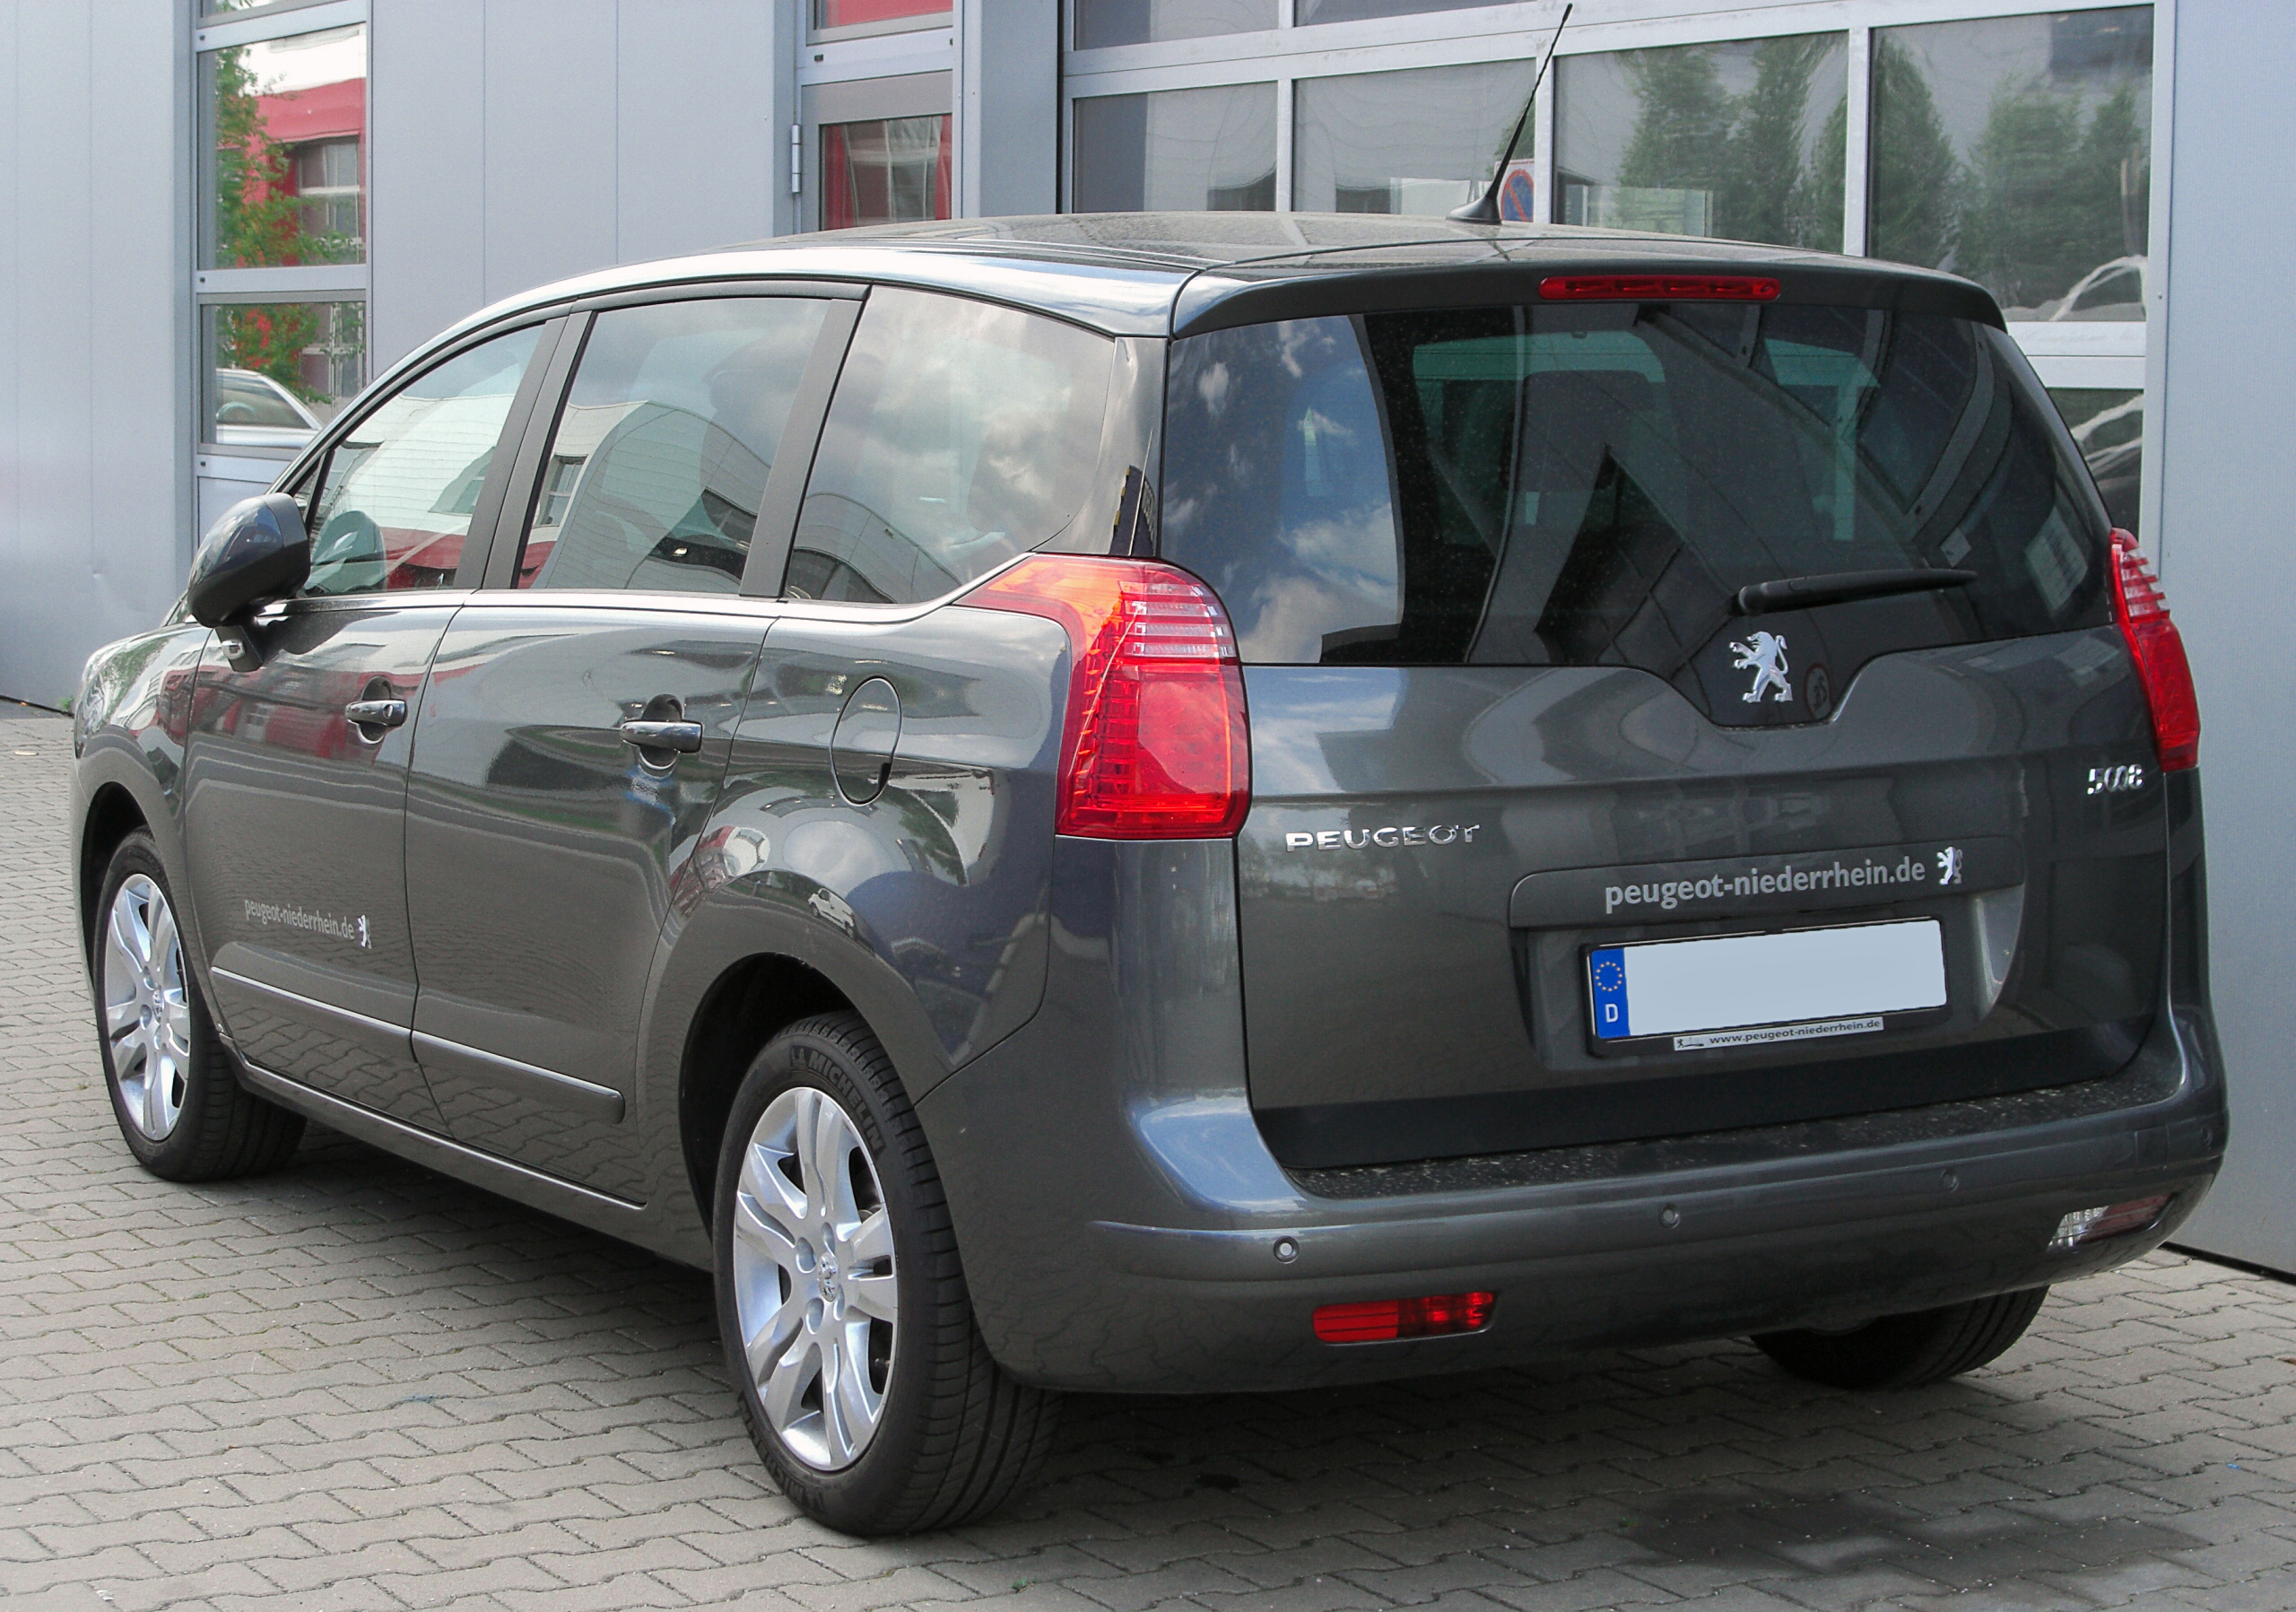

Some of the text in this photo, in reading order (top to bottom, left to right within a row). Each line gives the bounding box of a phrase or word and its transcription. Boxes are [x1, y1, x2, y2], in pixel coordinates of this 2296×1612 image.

[2087, 763, 2144, 795] 5008
[1285, 823, 1480, 852] PEUGEOT
[1605, 855, 1926, 913] peugeot-niederrhein.de
[244, 899, 355, 940] peugeot-niederrhein.de
[1604, 1002, 1619, 1024] D
[1709, 1019, 1881, 1044] www.peugeot-niederrhein.de
[808, 1050, 884, 1151] MICHELIN
